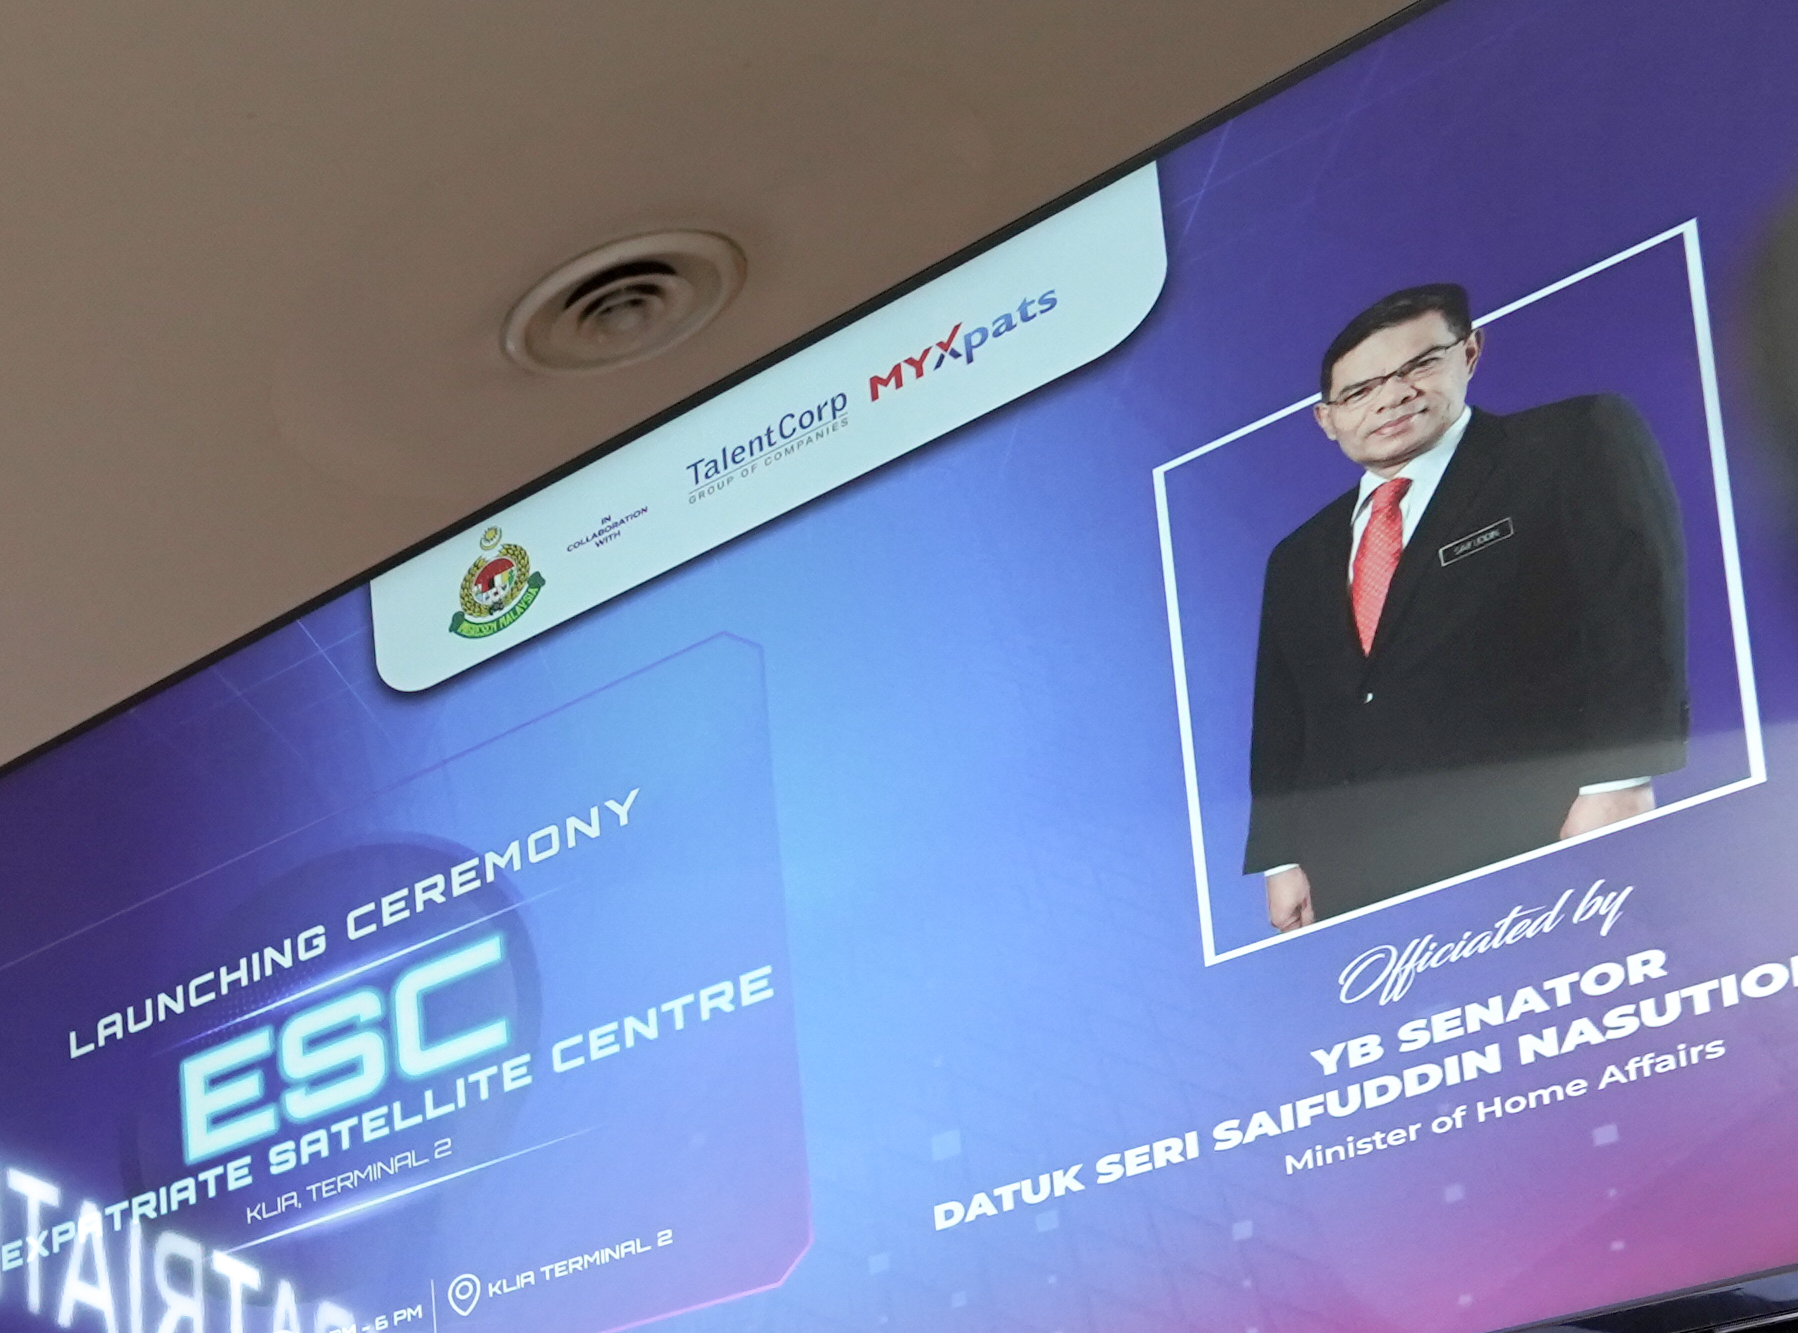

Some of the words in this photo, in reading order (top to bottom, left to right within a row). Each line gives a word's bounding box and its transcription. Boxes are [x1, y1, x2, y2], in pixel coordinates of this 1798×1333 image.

[868, 289, 1058, 402] MYXpats
[686, 392, 848, 486] TalentCorp
[689, 475, 735, 504] GROUP
[740, 464, 758, 479] OF
[764, 417, 850, 467] COMPANIES
[566, 506, 649, 553] COLLABORATION
[594, 530, 621, 549] WITH
[601, 514, 612, 526] IN
[68, 925, 328, 1059] LAUNCHING
[345, 787, 641, 940] CEREMONY
[1337, 888, 1575, 1007] Officiated
[1571, 878, 1635, 937] by
[180, 934, 512, 1166] ESC
[1310, 1032, 1385, 1077] YB
[1397, 948, 1668, 1054] SENATOR
[1, 1155, 253, 1272] EXPATRIATE
[269, 1053, 534, 1175] SATELLITE
[551, 964, 777, 1075] CENTRE
[932, 1163, 1085, 1232] DATUK
[1094, 1131, 1202, 1183] SERI
[1211, 1042, 1502, 1152] SAIFUDDIN
[1517, 953, 1798, 1066] NASUTIO
[1284, 1120, 1422, 1176] Minister
[1430, 1104, 1468, 1135] of
[1476, 1076, 1589, 1123] Home
[1597, 1037, 1727, 1091] Affairs
[246, 1191, 302, 1226] KLIA,
[306, 1152, 430, 1202] TERMINAL
[432, 1137, 453, 1160] 2
[487, 1270, 535, 1299] KLIA
[540, 1237, 650, 1285] TERMINAL
[655, 1228, 674, 1252] 2
[374, 1312, 388, 1333] 6
[391, 1304, 424, 1327] PM
